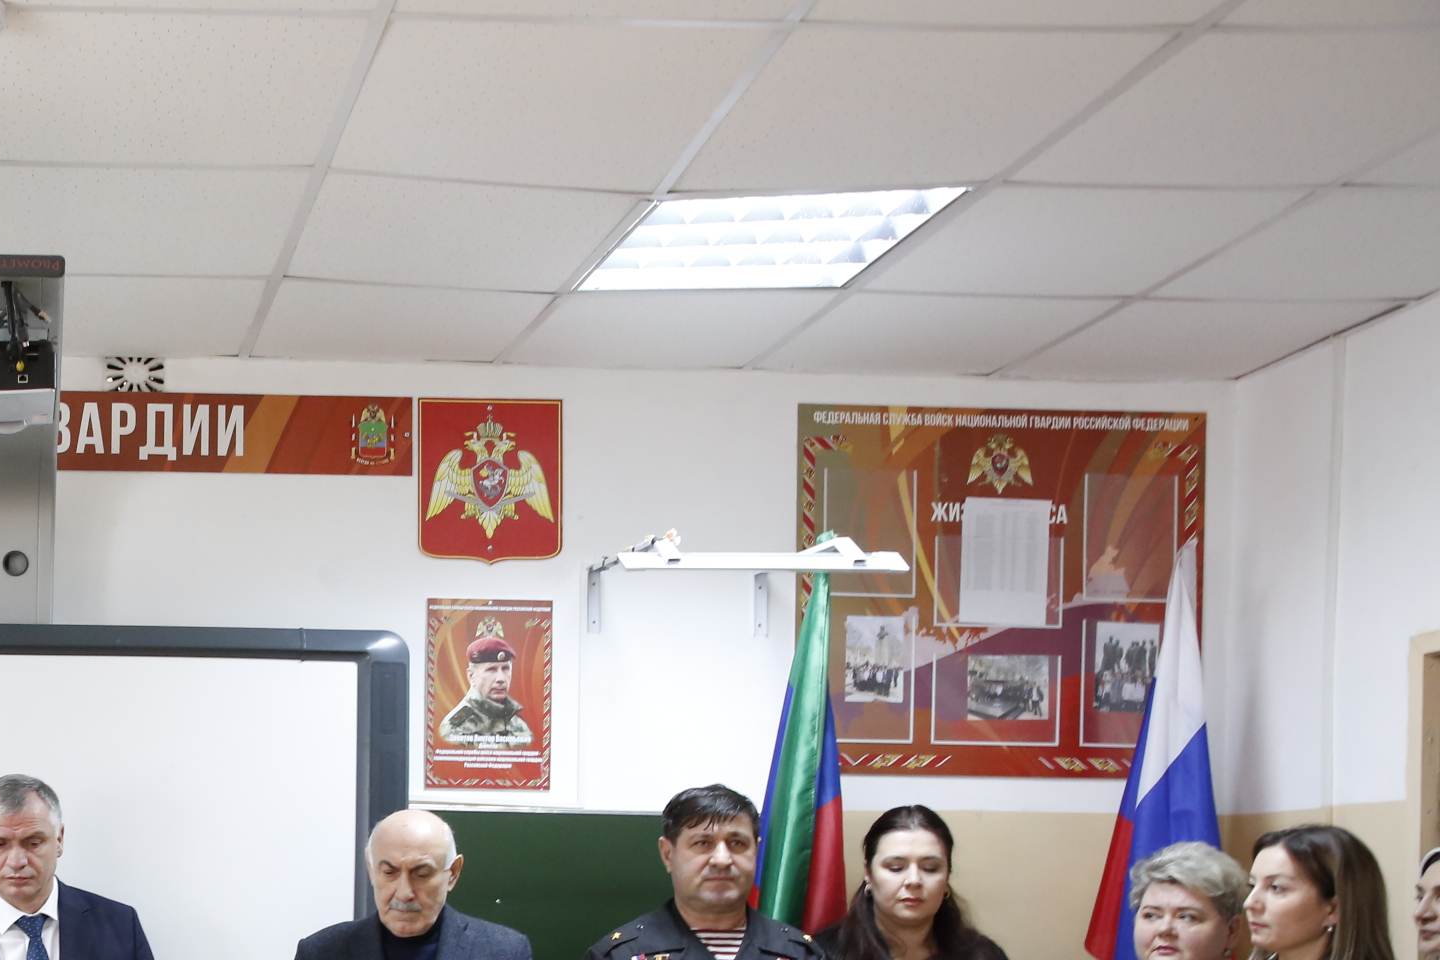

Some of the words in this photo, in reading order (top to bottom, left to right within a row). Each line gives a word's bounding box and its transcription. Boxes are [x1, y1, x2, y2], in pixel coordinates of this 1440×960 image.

[813, 411, 881, 425] ФЕДЕРАЛЬНАЯ
[882, 412, 923, 426] СЛУЖБА
[924, 412, 953, 427] ВОЙСК
[955, 413, 1028, 428] НАЦИОНАЛЬНОЙ
[1029, 416, 1071, 430] ГВАРДИИ
[1073, 415, 1131, 430] РОССИЙСКОЙ
[1132, 418, 1189, 431] ФЕДЕРАЦИИ
